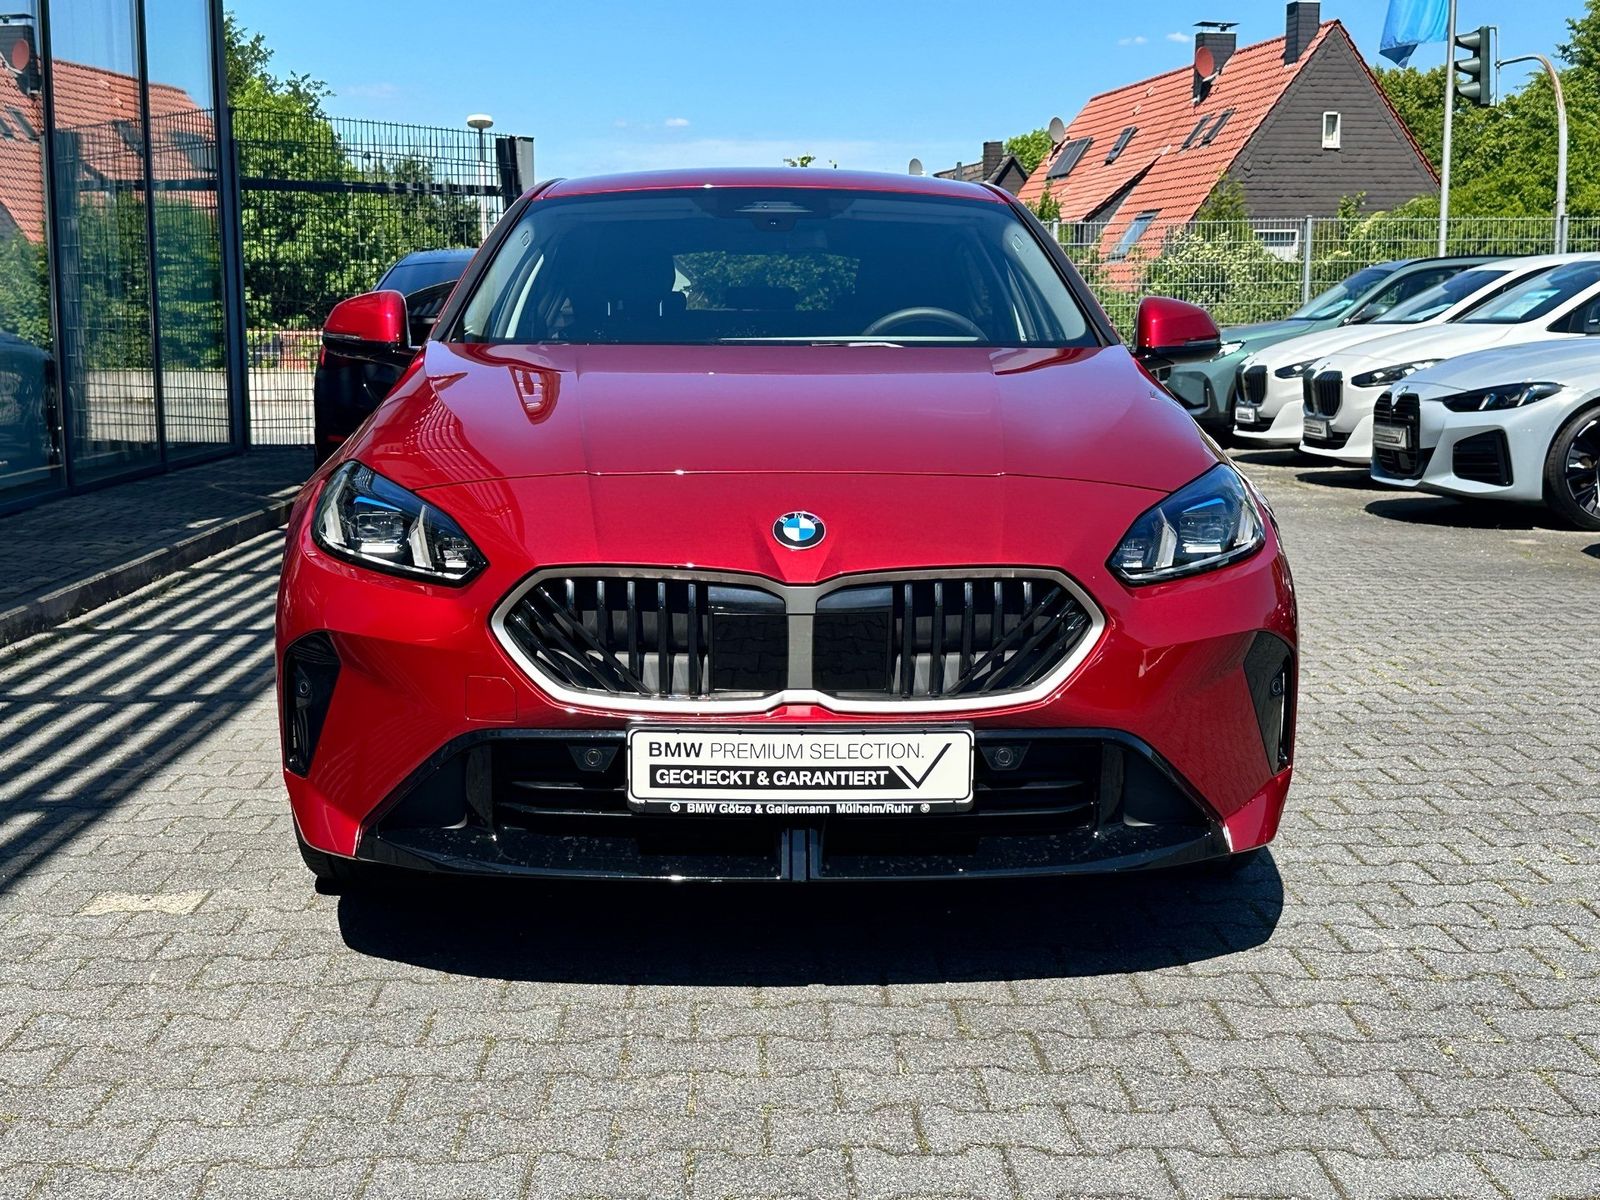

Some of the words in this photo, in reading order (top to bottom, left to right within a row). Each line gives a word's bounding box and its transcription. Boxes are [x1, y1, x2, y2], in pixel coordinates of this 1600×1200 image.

[649, 742, 703, 758] BMW
[710, 743, 803, 759] PREMIUM
[810, 743, 925, 759] SELECTION.
[655, 769, 754, 785] GECHECKT
[757, 771, 769, 785] &
[773, 770, 889, 786] GARANTIERT
[687, 803, 716, 814] BMW
[719, 802, 751, 814] Götze
[754, 804, 763, 814] &
